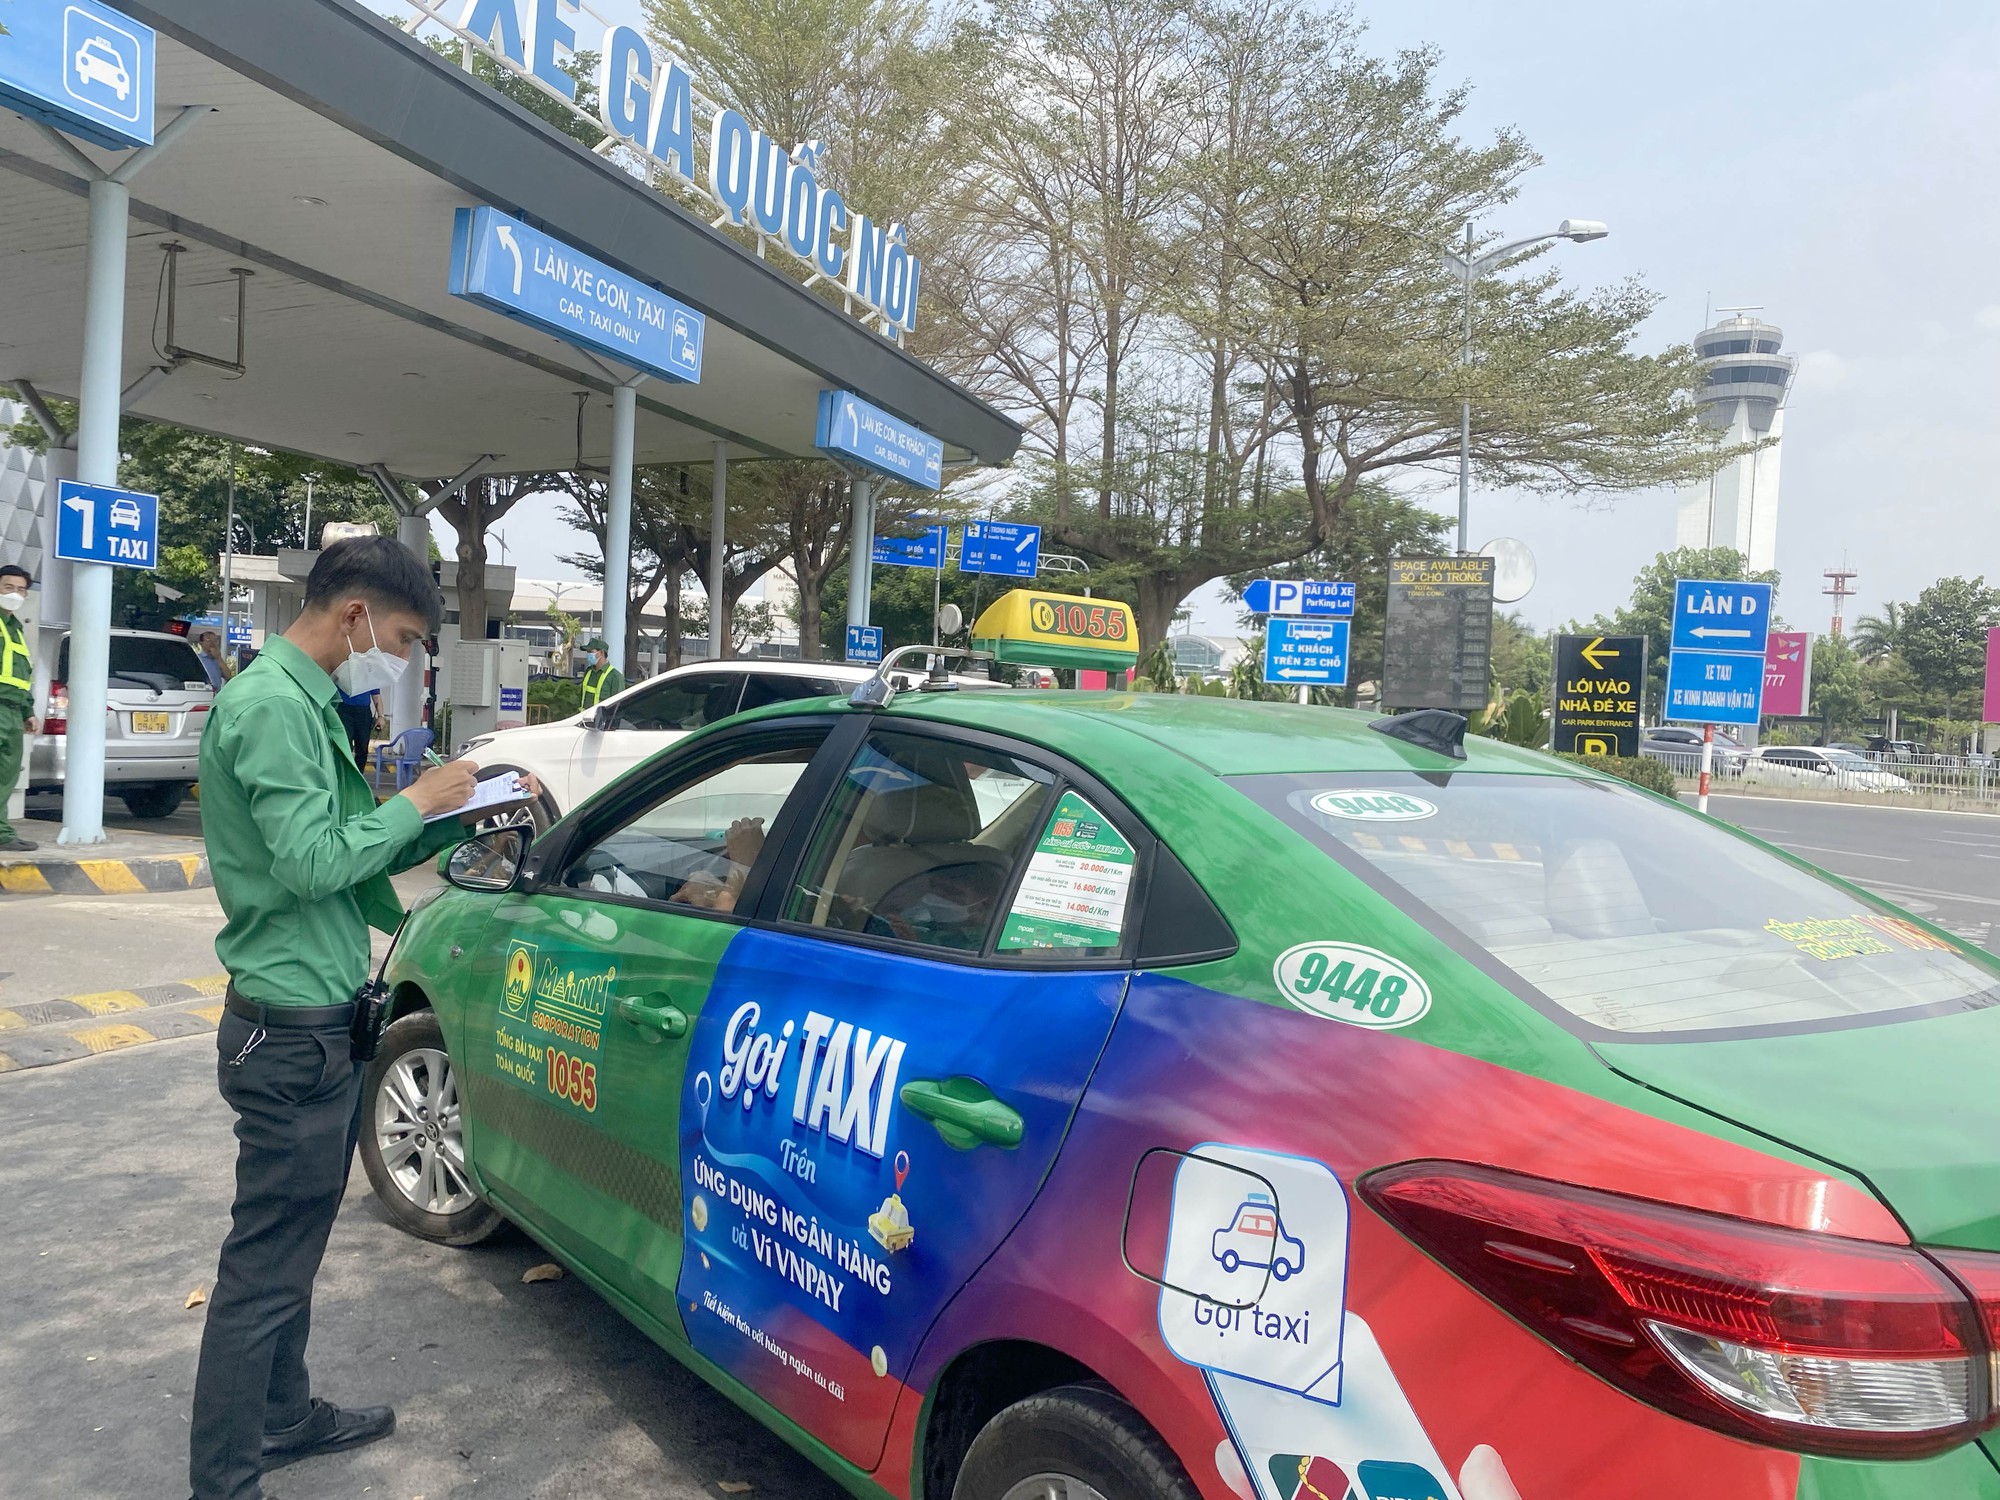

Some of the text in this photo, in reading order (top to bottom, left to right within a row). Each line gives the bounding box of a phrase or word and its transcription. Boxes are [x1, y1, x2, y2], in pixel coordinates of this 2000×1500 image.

[600, 26, 694, 182] GA
[709, 110, 846, 278] QUỐC
[850, 214, 921, 342] NỘI
[534, 247, 665, 330] LÀN XE CON, TAXI
[559, 298, 640, 344] CAR, TAXI ONLY
[874, 421, 882, 437] XE
[884, 425, 897, 447] CON,
[898, 432, 906, 448] XE
[906, 437, 926, 458] KHÁCH
[888, 448, 897, 463] BUS
[898, 457, 910, 468] ONLY
[107, 536, 148, 560] TAXI
[1394, 561, 1489, 570] SPACE AVAILABLE
[1275, 582, 1354, 610] P BÃI ĐỖ XE
[1306, 598, 1350, 609] ParKing Lot
[1687, 590, 1756, 615] LÀN D
[1055, 604, 1125, 639] 1055
[1273, 655, 1341, 667] TRÊN 25 CHỖ
[1282, 643, 1333, 654] XE KHÁCH
[1567, 678, 1631, 694] LỐI VÀO
[1705, 665, 1732, 680] XE TAXI
[1560, 697, 1591, 712] NHÀ
[1617, 701, 1636, 713] XE
[1673, 687, 1754, 710] XE KINH DOANH VẬN TẢI
[1328, 795, 1423, 815] 9448
[1052, 822, 1076, 837] 1055
[1294, 952, 1408, 1018] 9448
[496, 1026, 542, 1063] TỔNG ĐÀI TAXI
[532, 1011, 600, 1050] CORPORATION
[496, 1052, 536, 1085] TOÀN QUỐC
[547, 1046, 596, 1113] 1055
[793, 1010, 907, 1160] TAXI
[780, 1138, 816, 1184] Trên
[694, 1155, 891, 1295] ỨNG DỤNG NGÂN HÀNG
[732, 1223, 844, 1312] và Ví VNPAY
[1194, 1294, 1309, 1344] Gọi taxi
[704, 1290, 844, 1402] Tiết kiệm hơn với hàng ngàn ưu đãi
